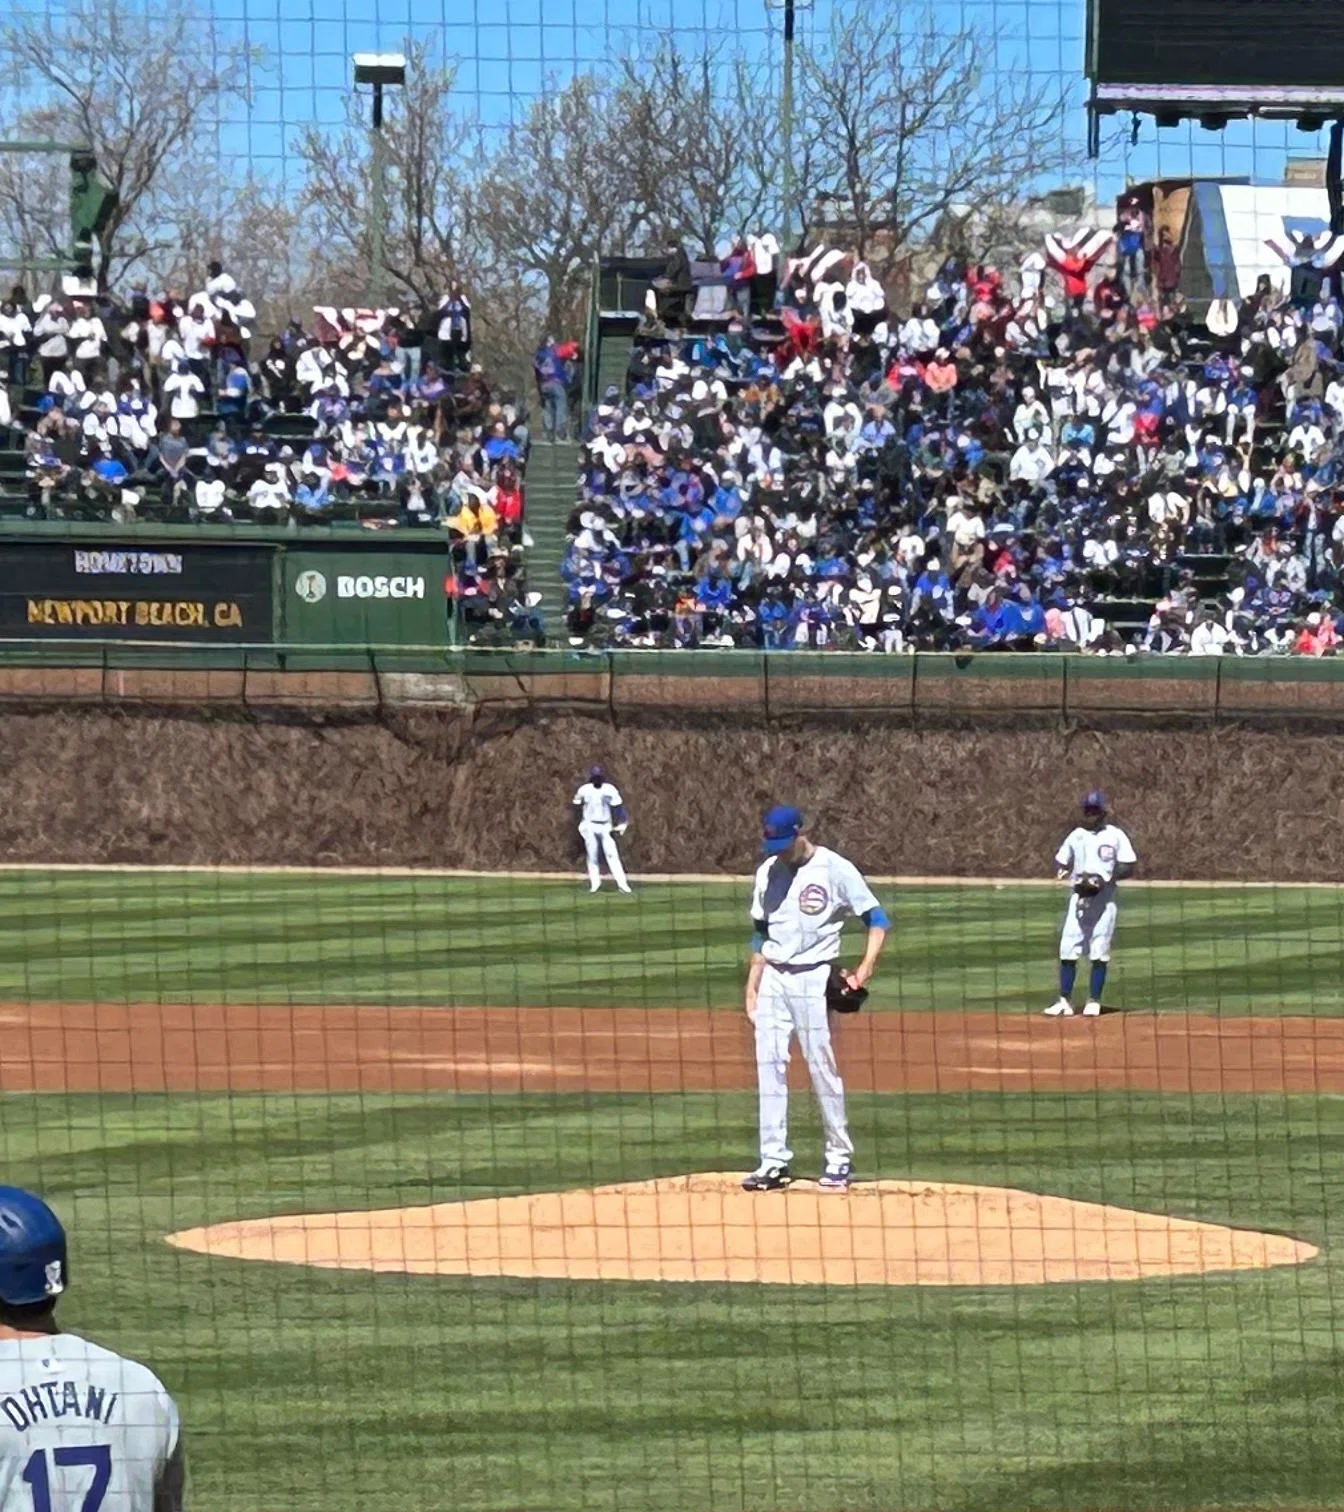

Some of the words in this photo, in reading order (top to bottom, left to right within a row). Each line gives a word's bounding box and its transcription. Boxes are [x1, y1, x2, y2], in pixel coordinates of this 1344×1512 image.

[337, 575, 425, 599] BOSCH
[213, 601, 243, 628] CA
[0, 1380, 118, 1434] OHTANI
